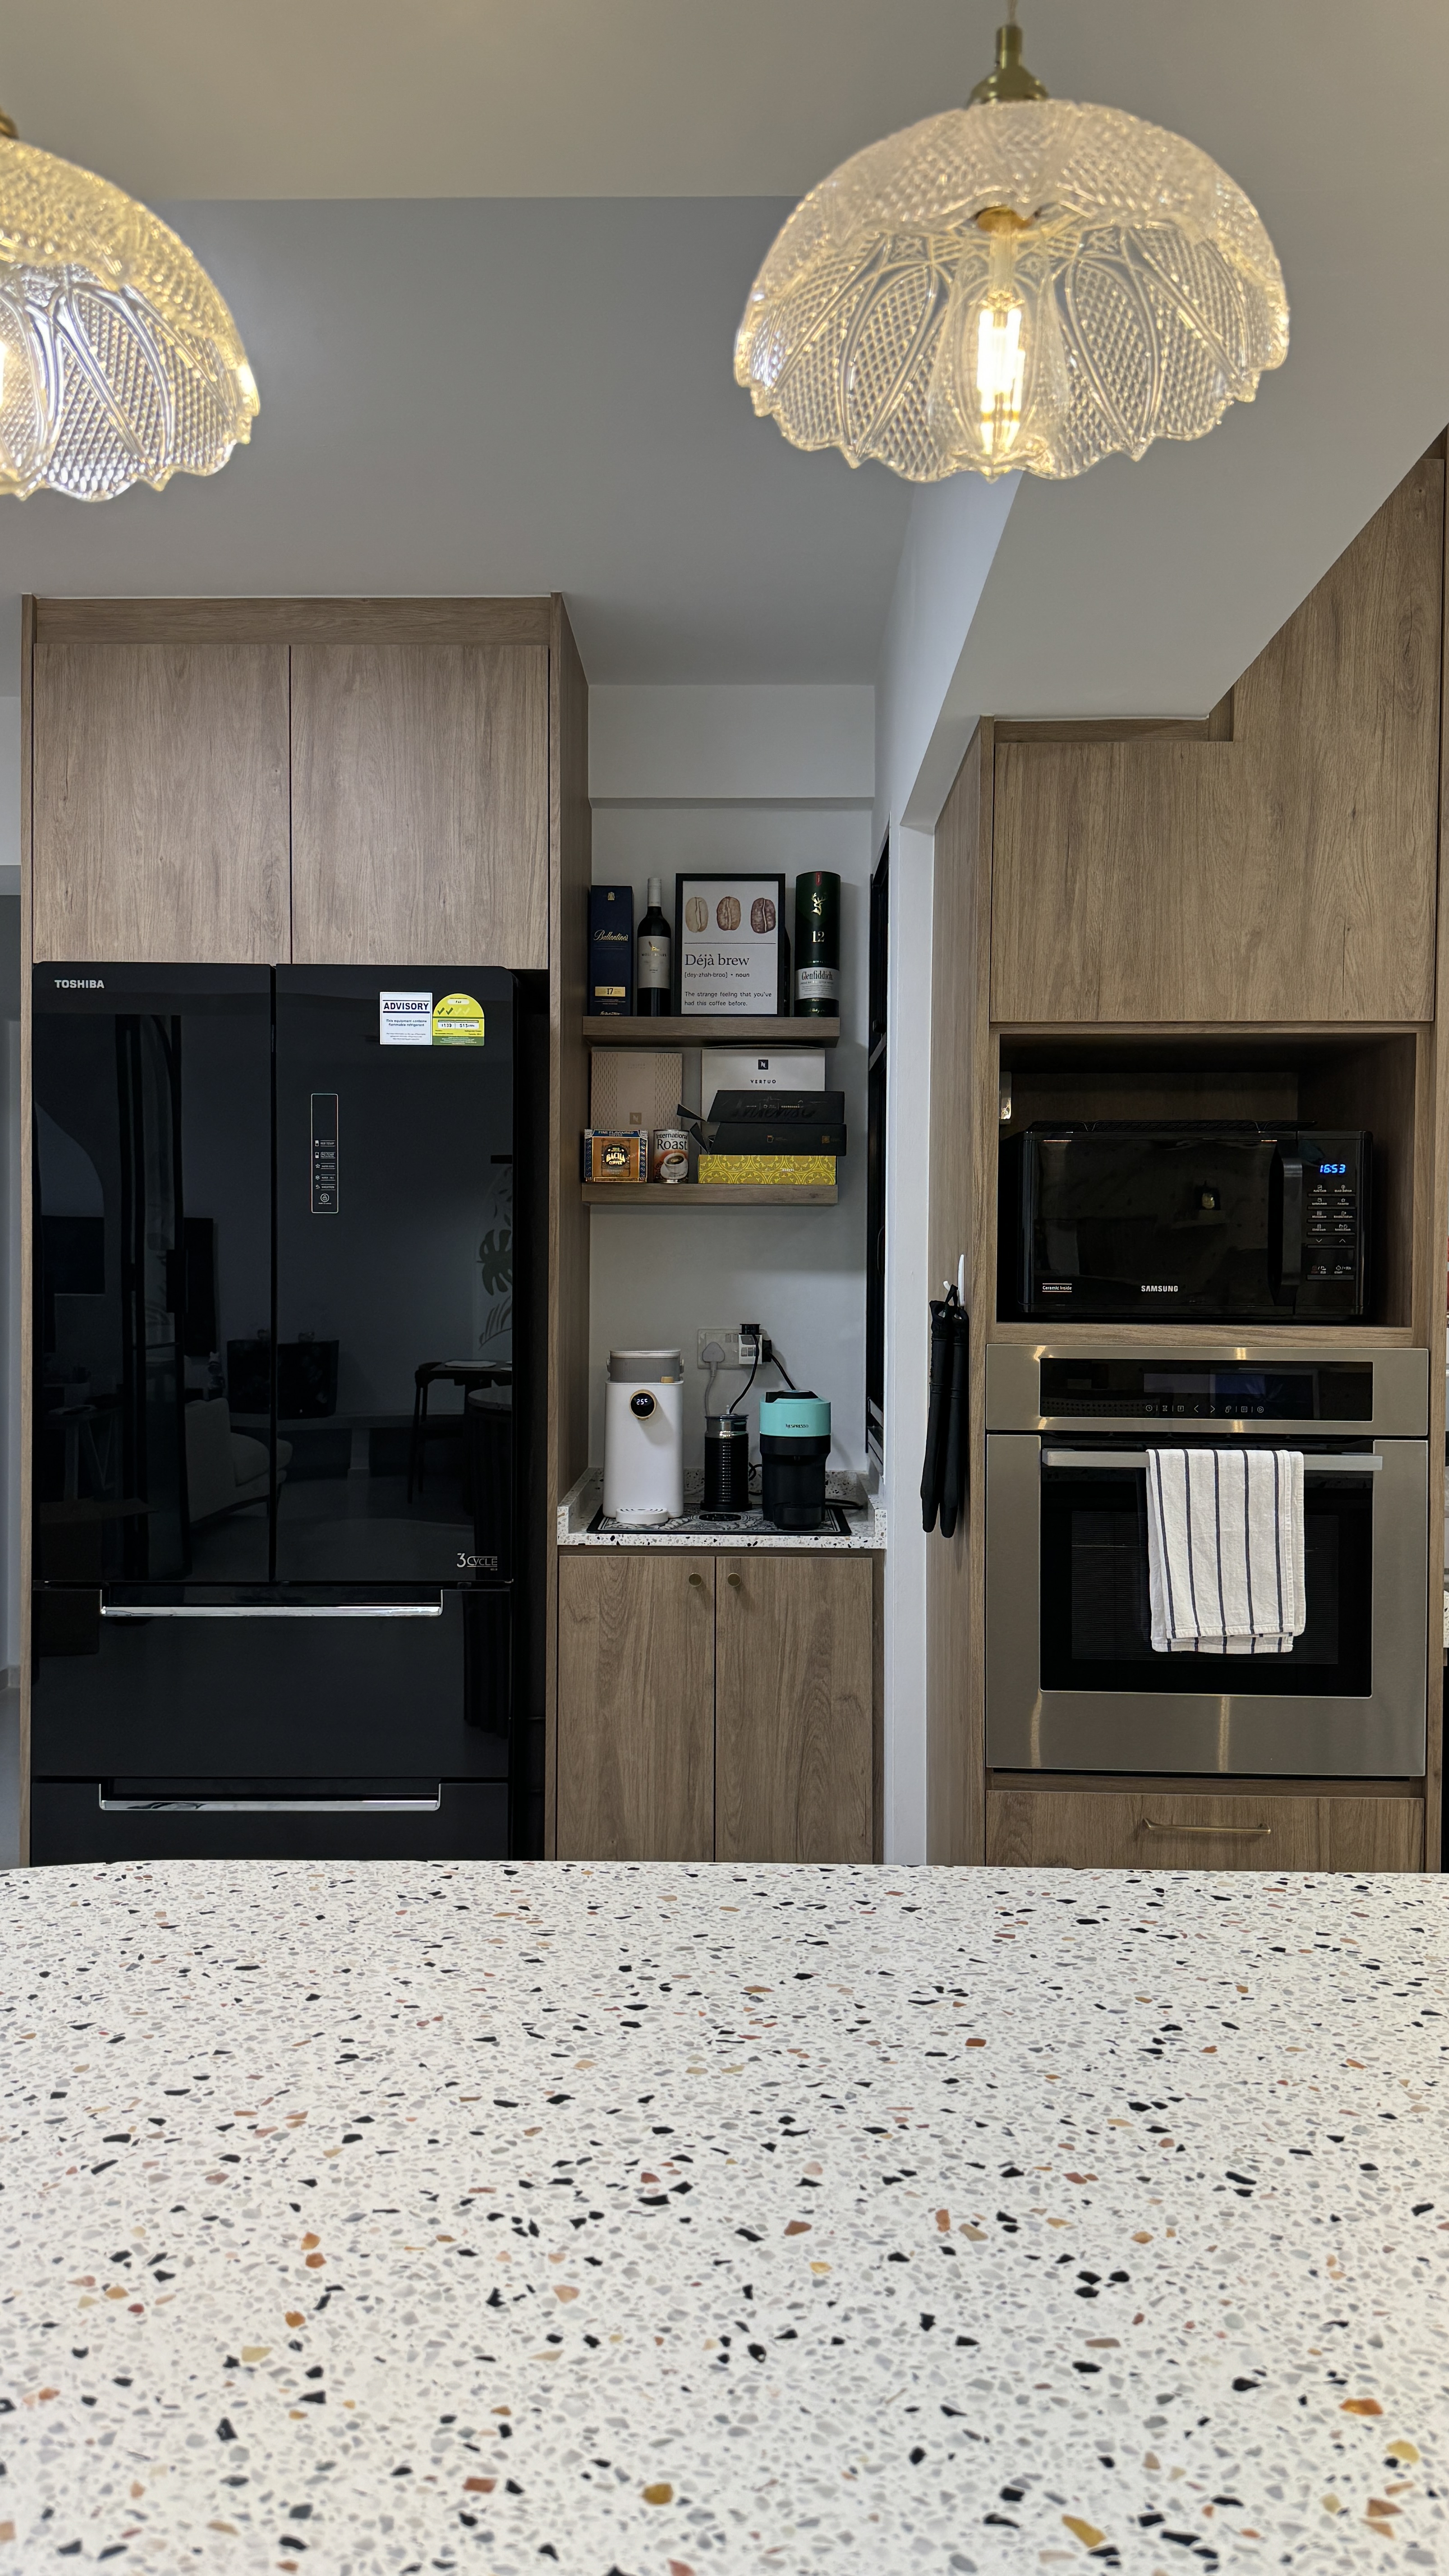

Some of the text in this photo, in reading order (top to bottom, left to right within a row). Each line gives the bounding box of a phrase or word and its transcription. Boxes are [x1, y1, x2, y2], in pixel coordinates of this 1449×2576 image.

[812, 930, 824, 943] 12
[685, 953, 750, 969] Déjà brew
[802, 970, 833, 980] Glenfiddich
[54, 980, 105, 988] TOSHIBA
[384, 1002, 428, 1010] ADVISORY
[657, 1139, 688, 1150] Roast
[1320, 1164, 1346, 1173] 16:53
